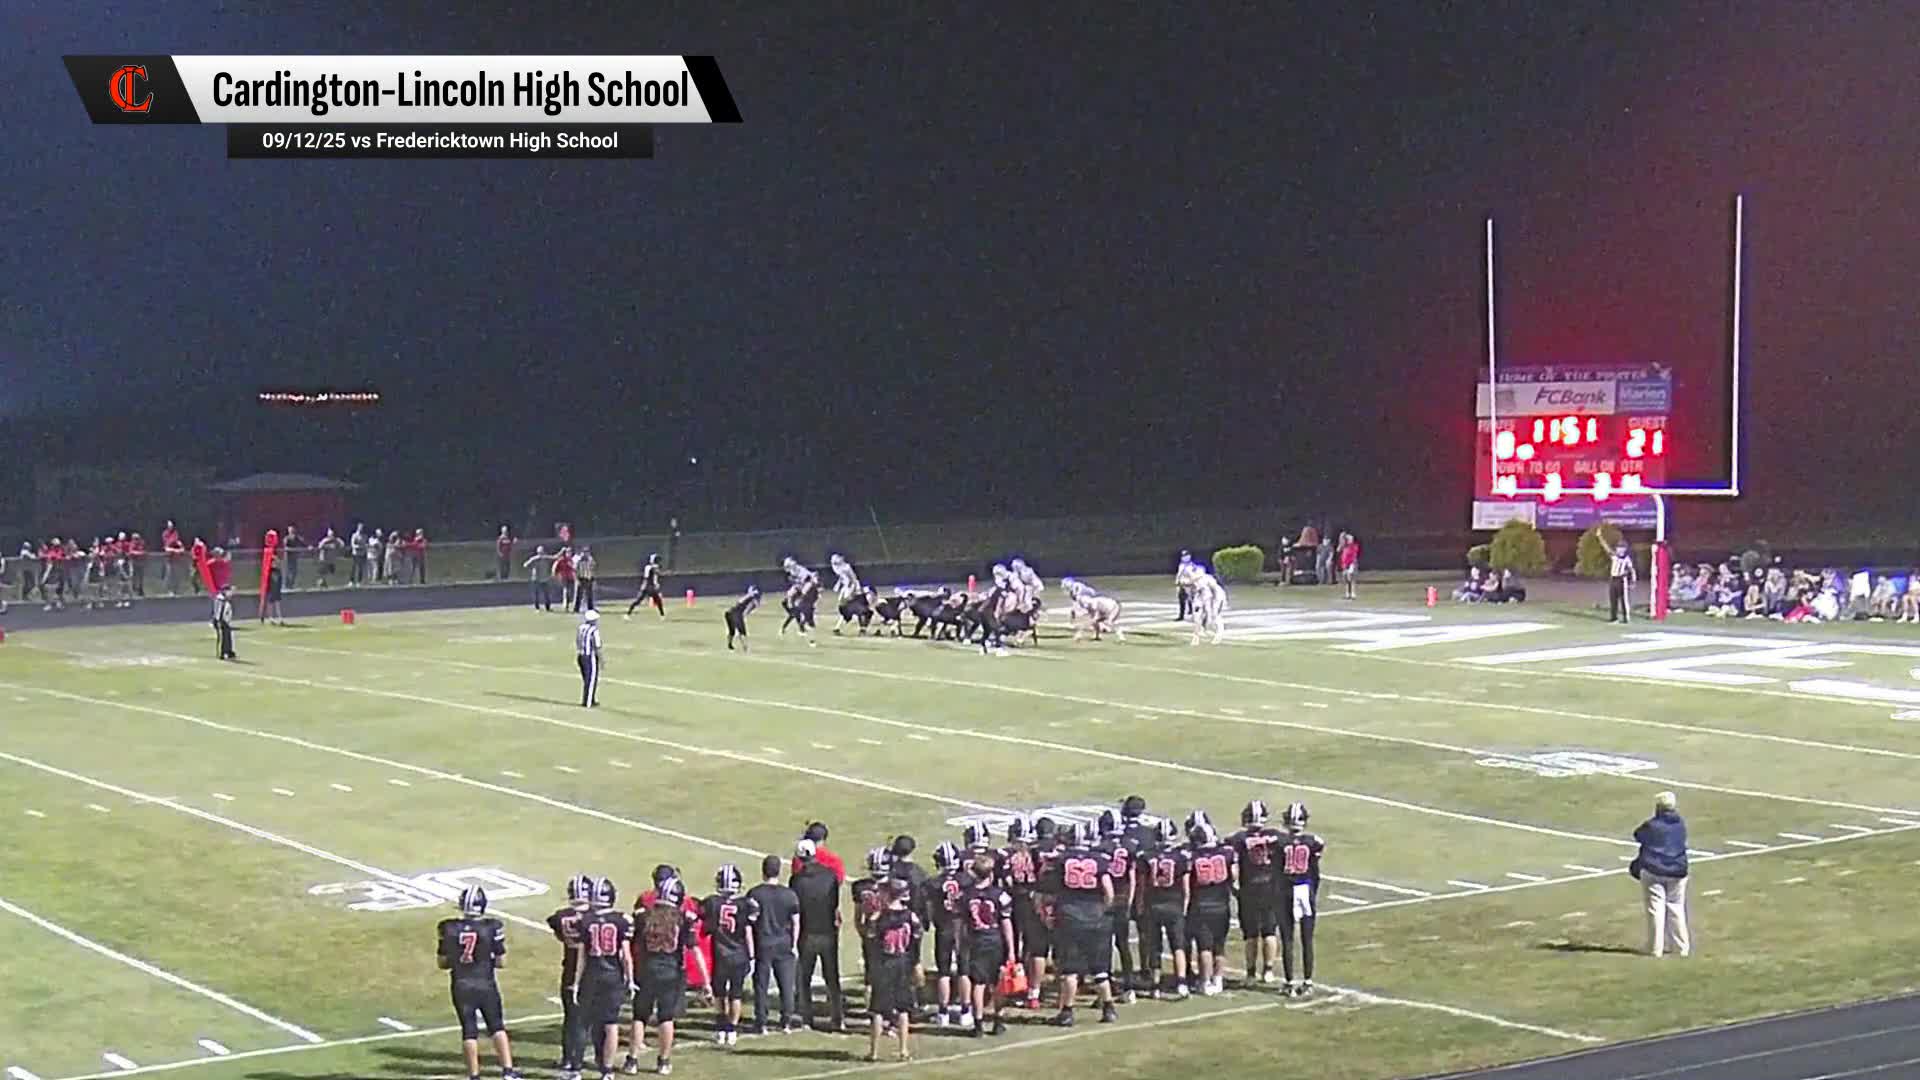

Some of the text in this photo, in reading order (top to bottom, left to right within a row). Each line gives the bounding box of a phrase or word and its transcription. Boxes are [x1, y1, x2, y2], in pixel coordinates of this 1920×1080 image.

[1533, 387, 1608, 405] FCBank
[1626, 428, 1663, 457] 21
[1064, 858, 1098, 889] 62
[718, 904, 738, 934] 5
[459, 932, 478, 964] 7
